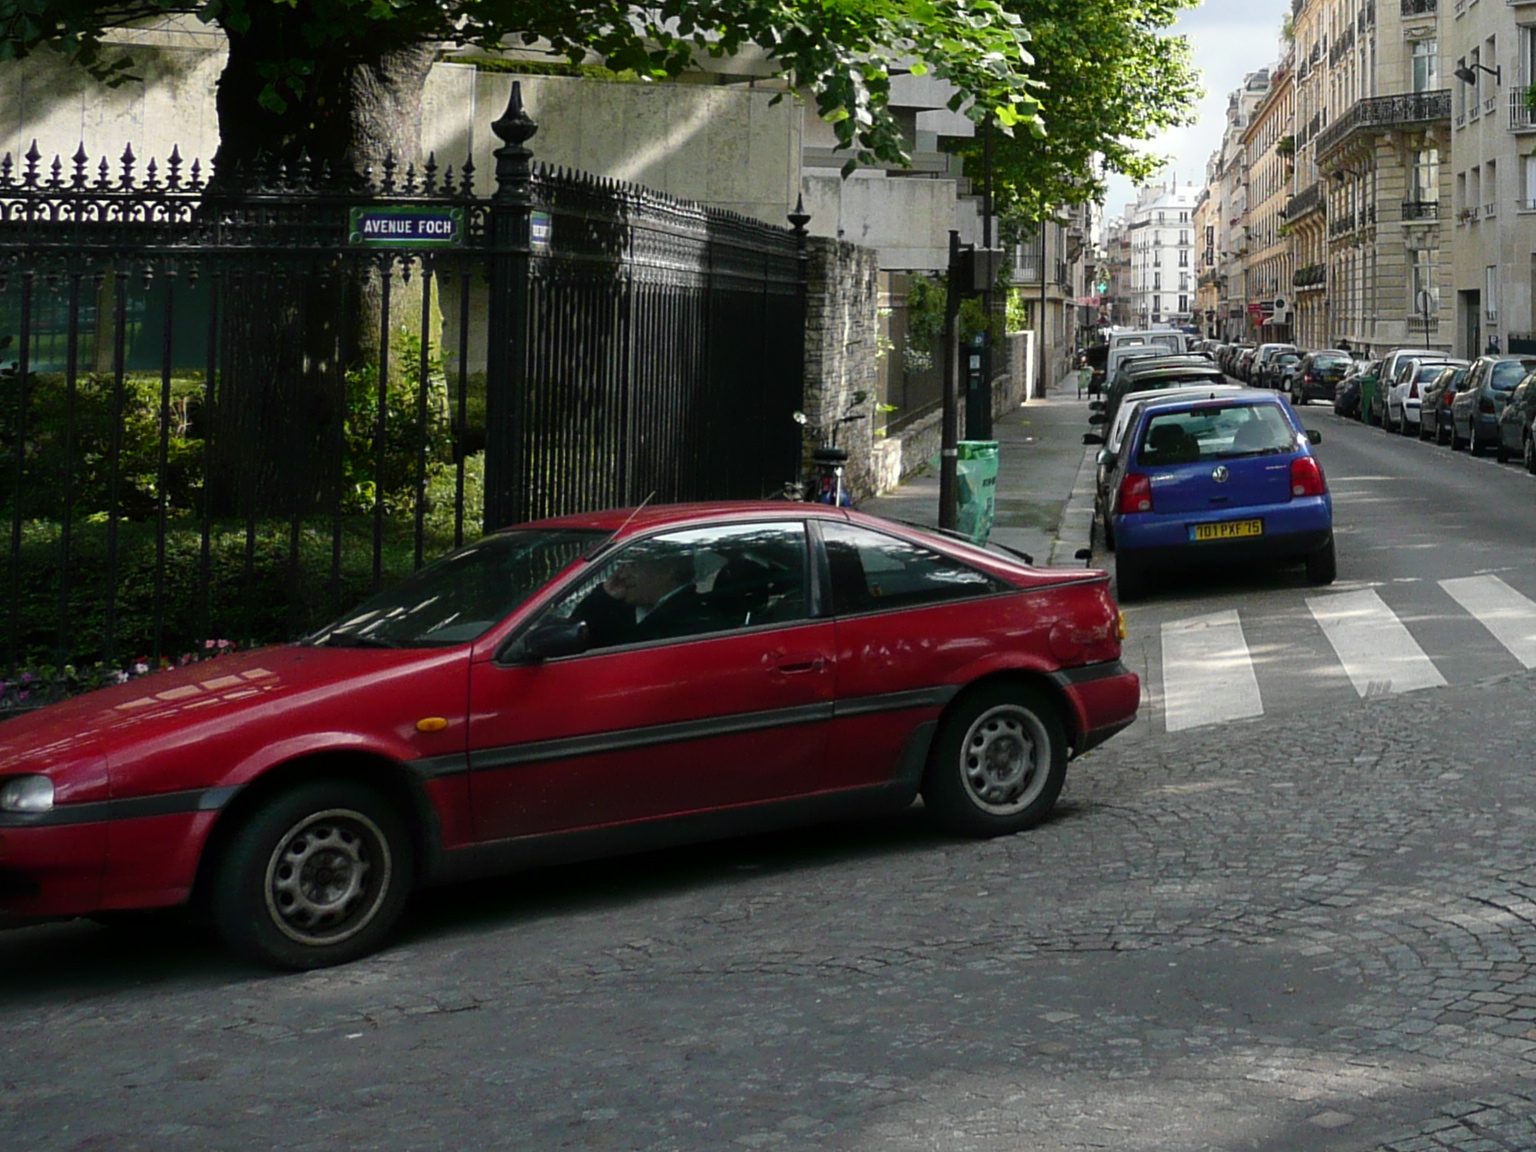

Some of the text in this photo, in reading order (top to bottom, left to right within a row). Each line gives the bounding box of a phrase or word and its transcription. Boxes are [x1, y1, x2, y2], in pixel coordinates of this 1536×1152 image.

[363, 220, 452, 234] AVENUE FOCH
[1197, 521, 1260, 538] 701 PXF 75
